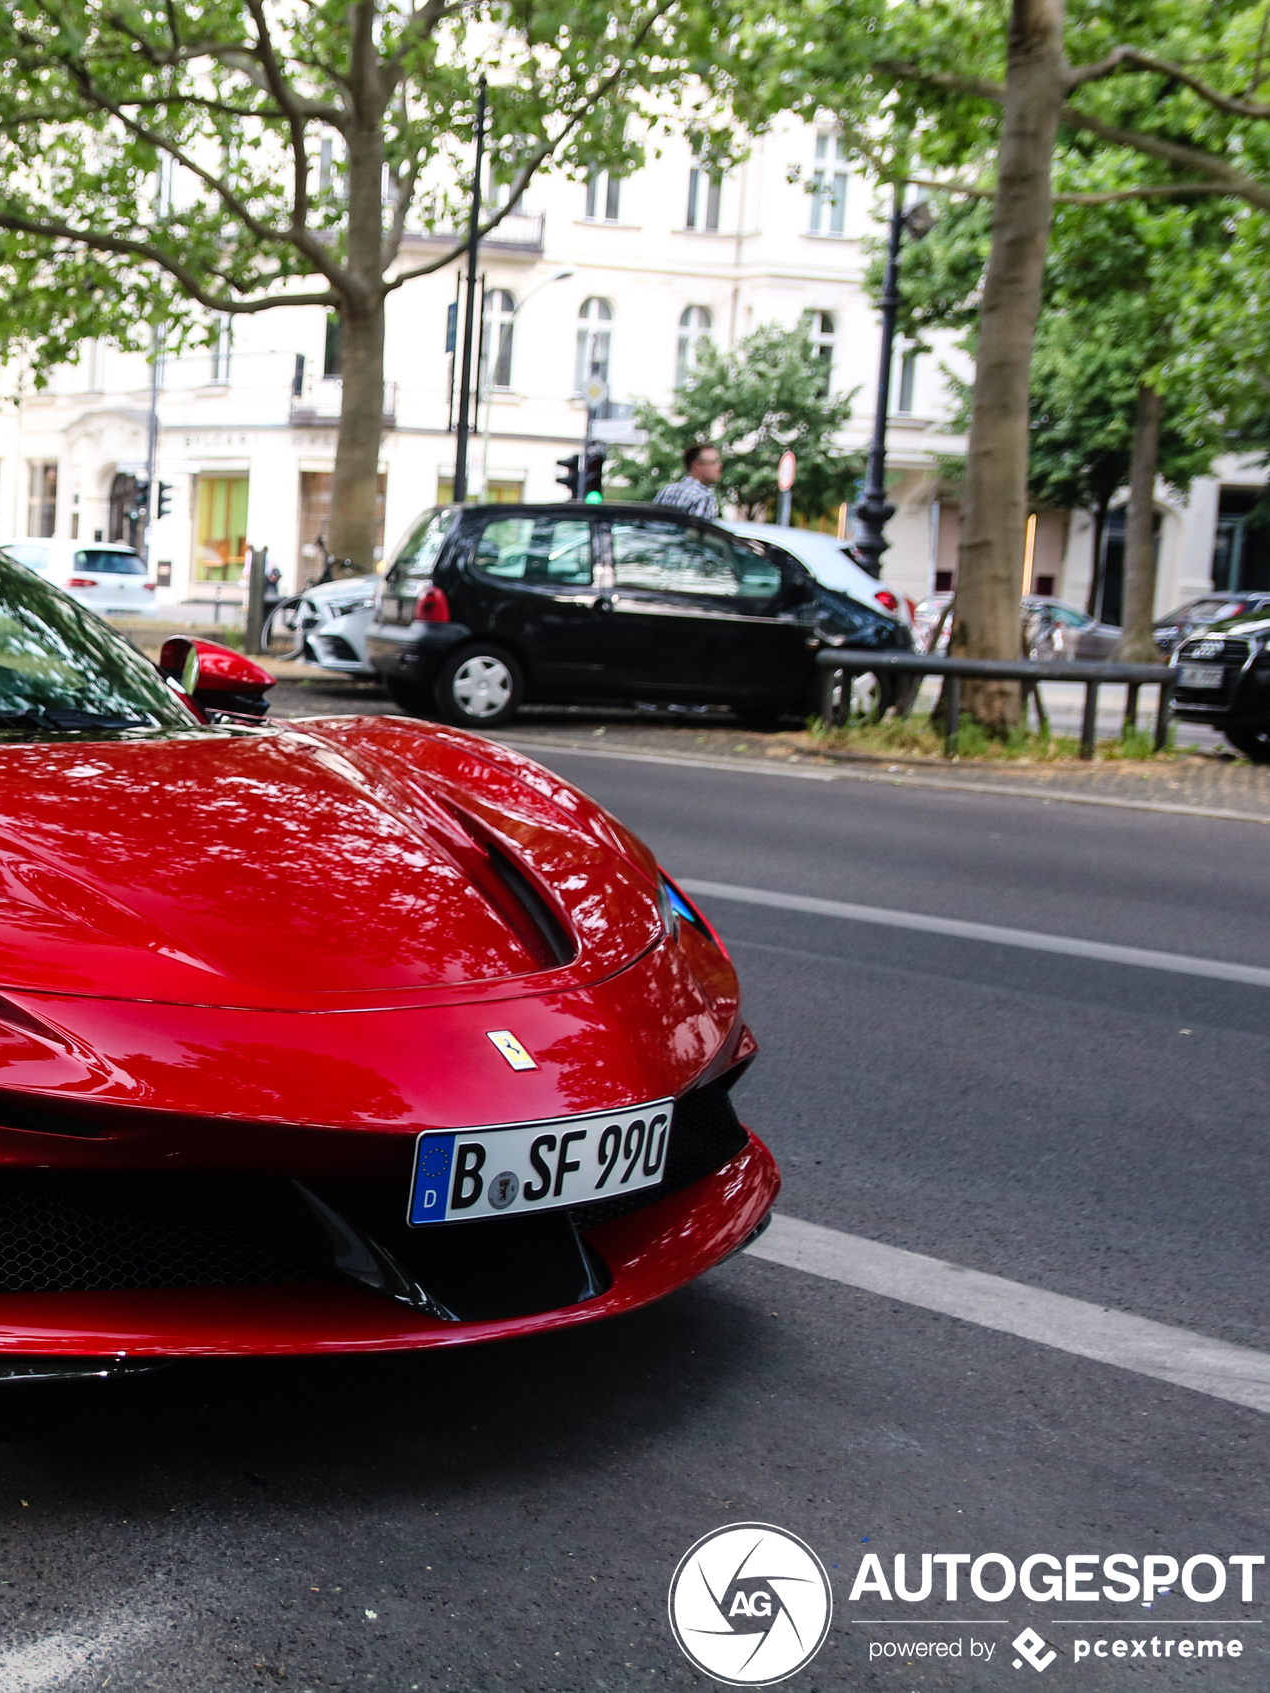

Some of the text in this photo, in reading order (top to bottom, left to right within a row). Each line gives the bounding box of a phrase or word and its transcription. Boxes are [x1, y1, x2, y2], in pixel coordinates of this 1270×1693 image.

[450, 1143, 487, 1210] B
[523, 1130, 587, 1202] SF
[594, 1113, 668, 1190] 990
[422, 1189, 437, 1208] D
